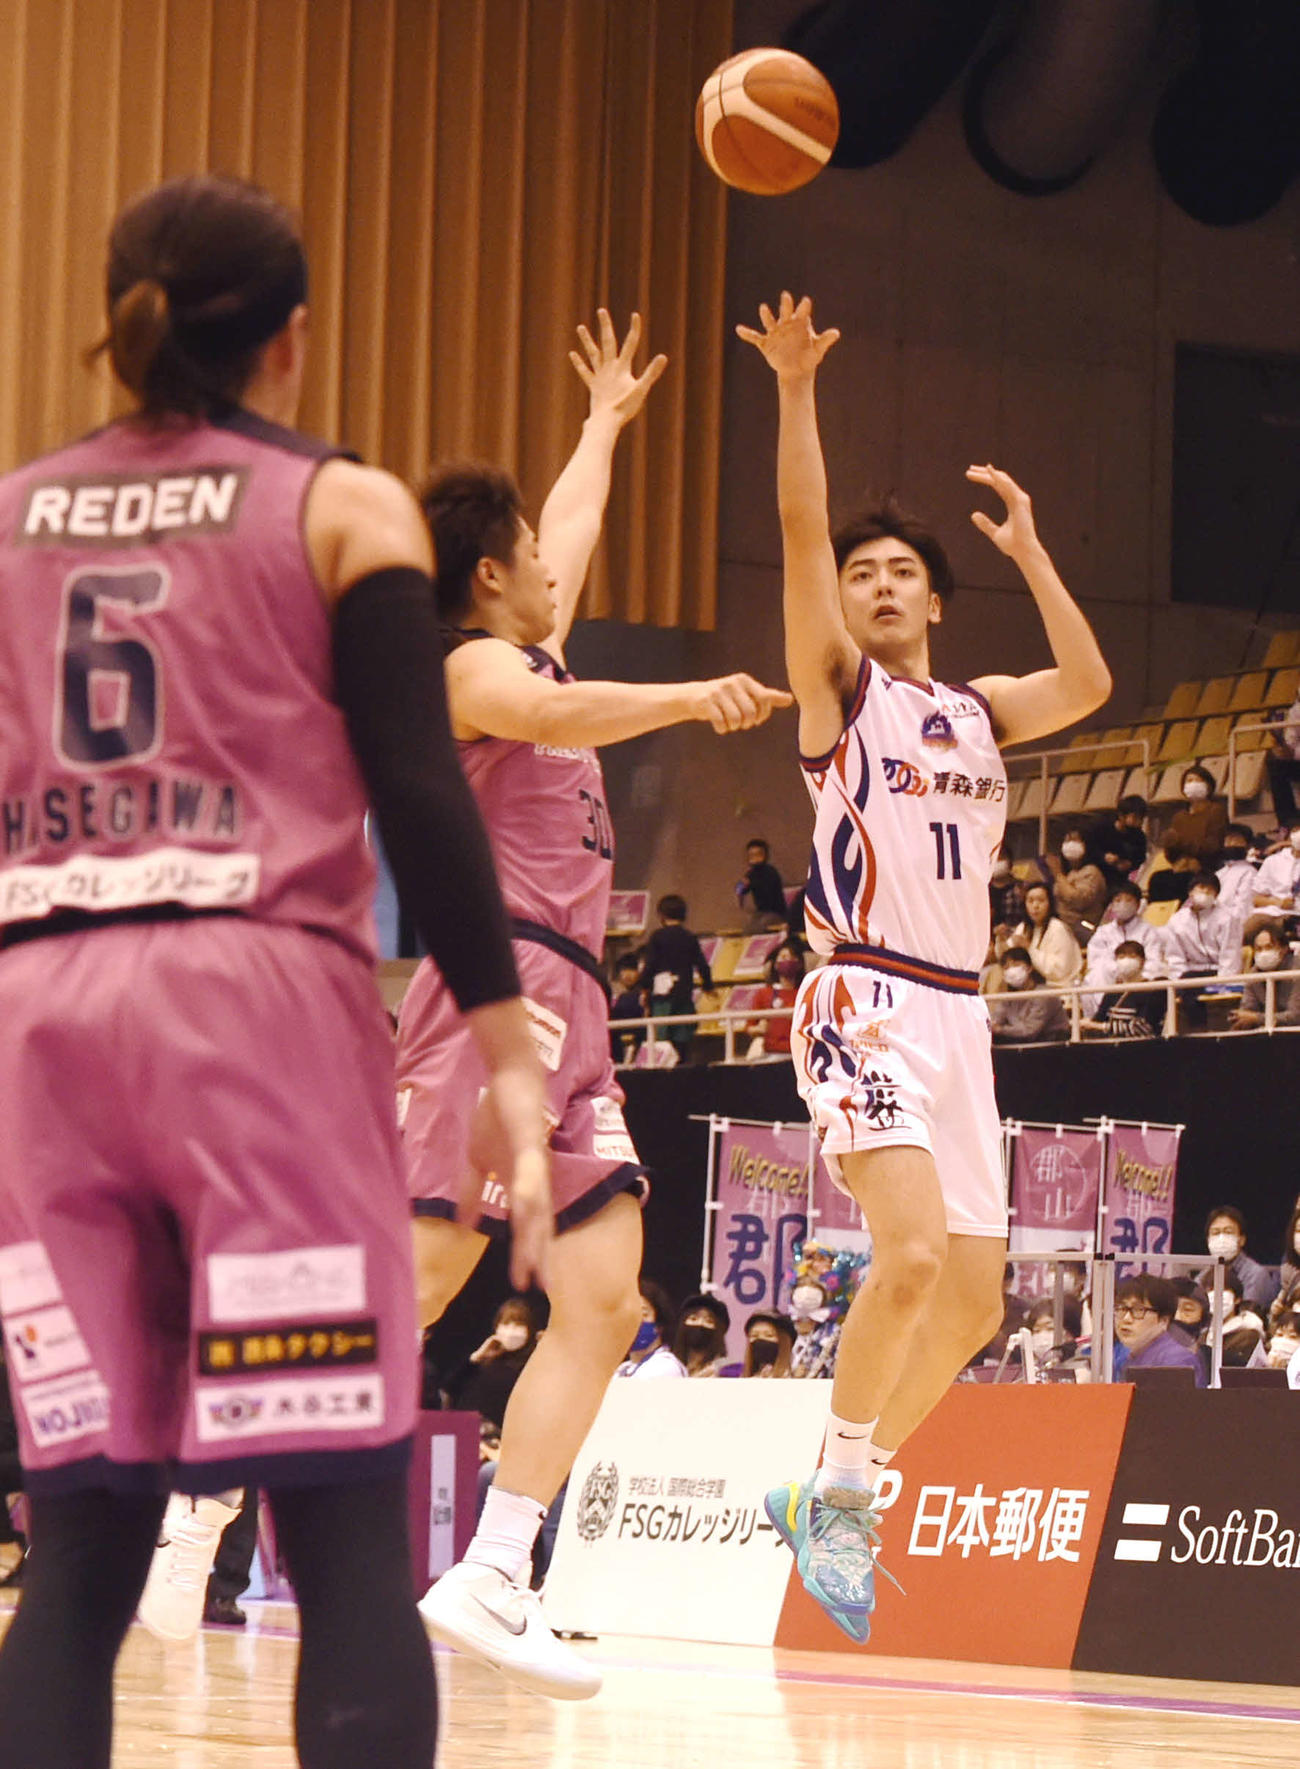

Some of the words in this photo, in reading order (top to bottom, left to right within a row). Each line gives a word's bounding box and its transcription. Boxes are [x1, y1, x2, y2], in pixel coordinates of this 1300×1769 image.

[24, 474, 238, 537] REDEN
[54, 564, 170, 770] 6
[932, 771, 1006, 803] 青森銀行
[929, 822, 962, 880] 11
[872, 980, 893, 1008] 11
[617, 1502, 786, 1548] FSGカレッジリー
[907, 1483, 1090, 1563] 日本郵便
